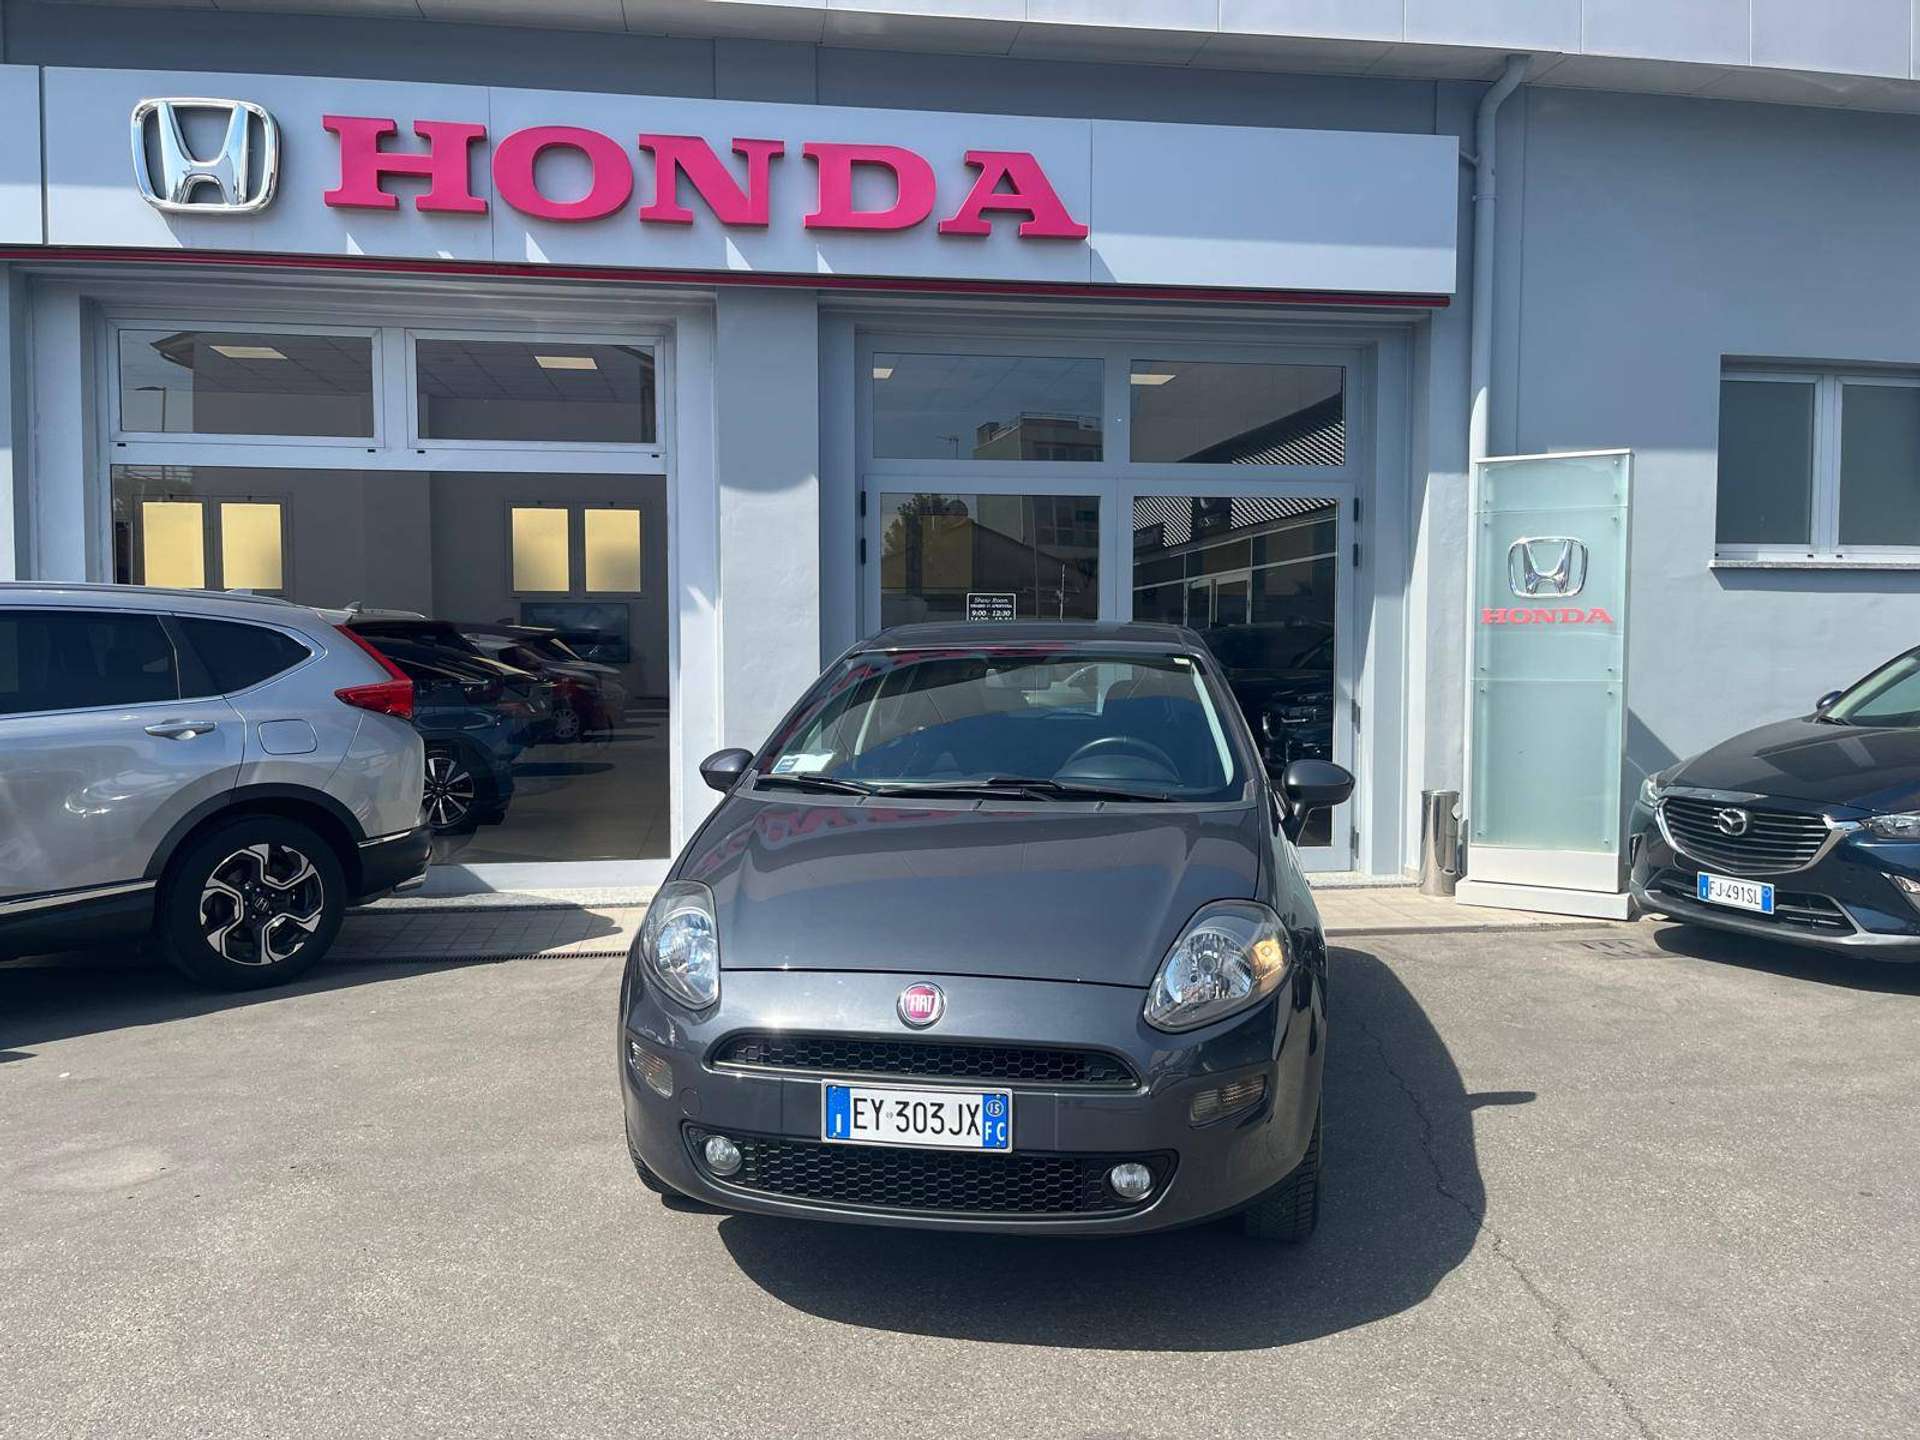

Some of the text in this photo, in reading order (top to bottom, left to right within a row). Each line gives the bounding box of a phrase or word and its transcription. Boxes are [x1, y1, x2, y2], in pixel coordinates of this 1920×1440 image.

[323, 115, 1088, 240] HONDA
[1480, 608, 1614, 625] HONDA
[908, 994, 935, 1012] FIAT
